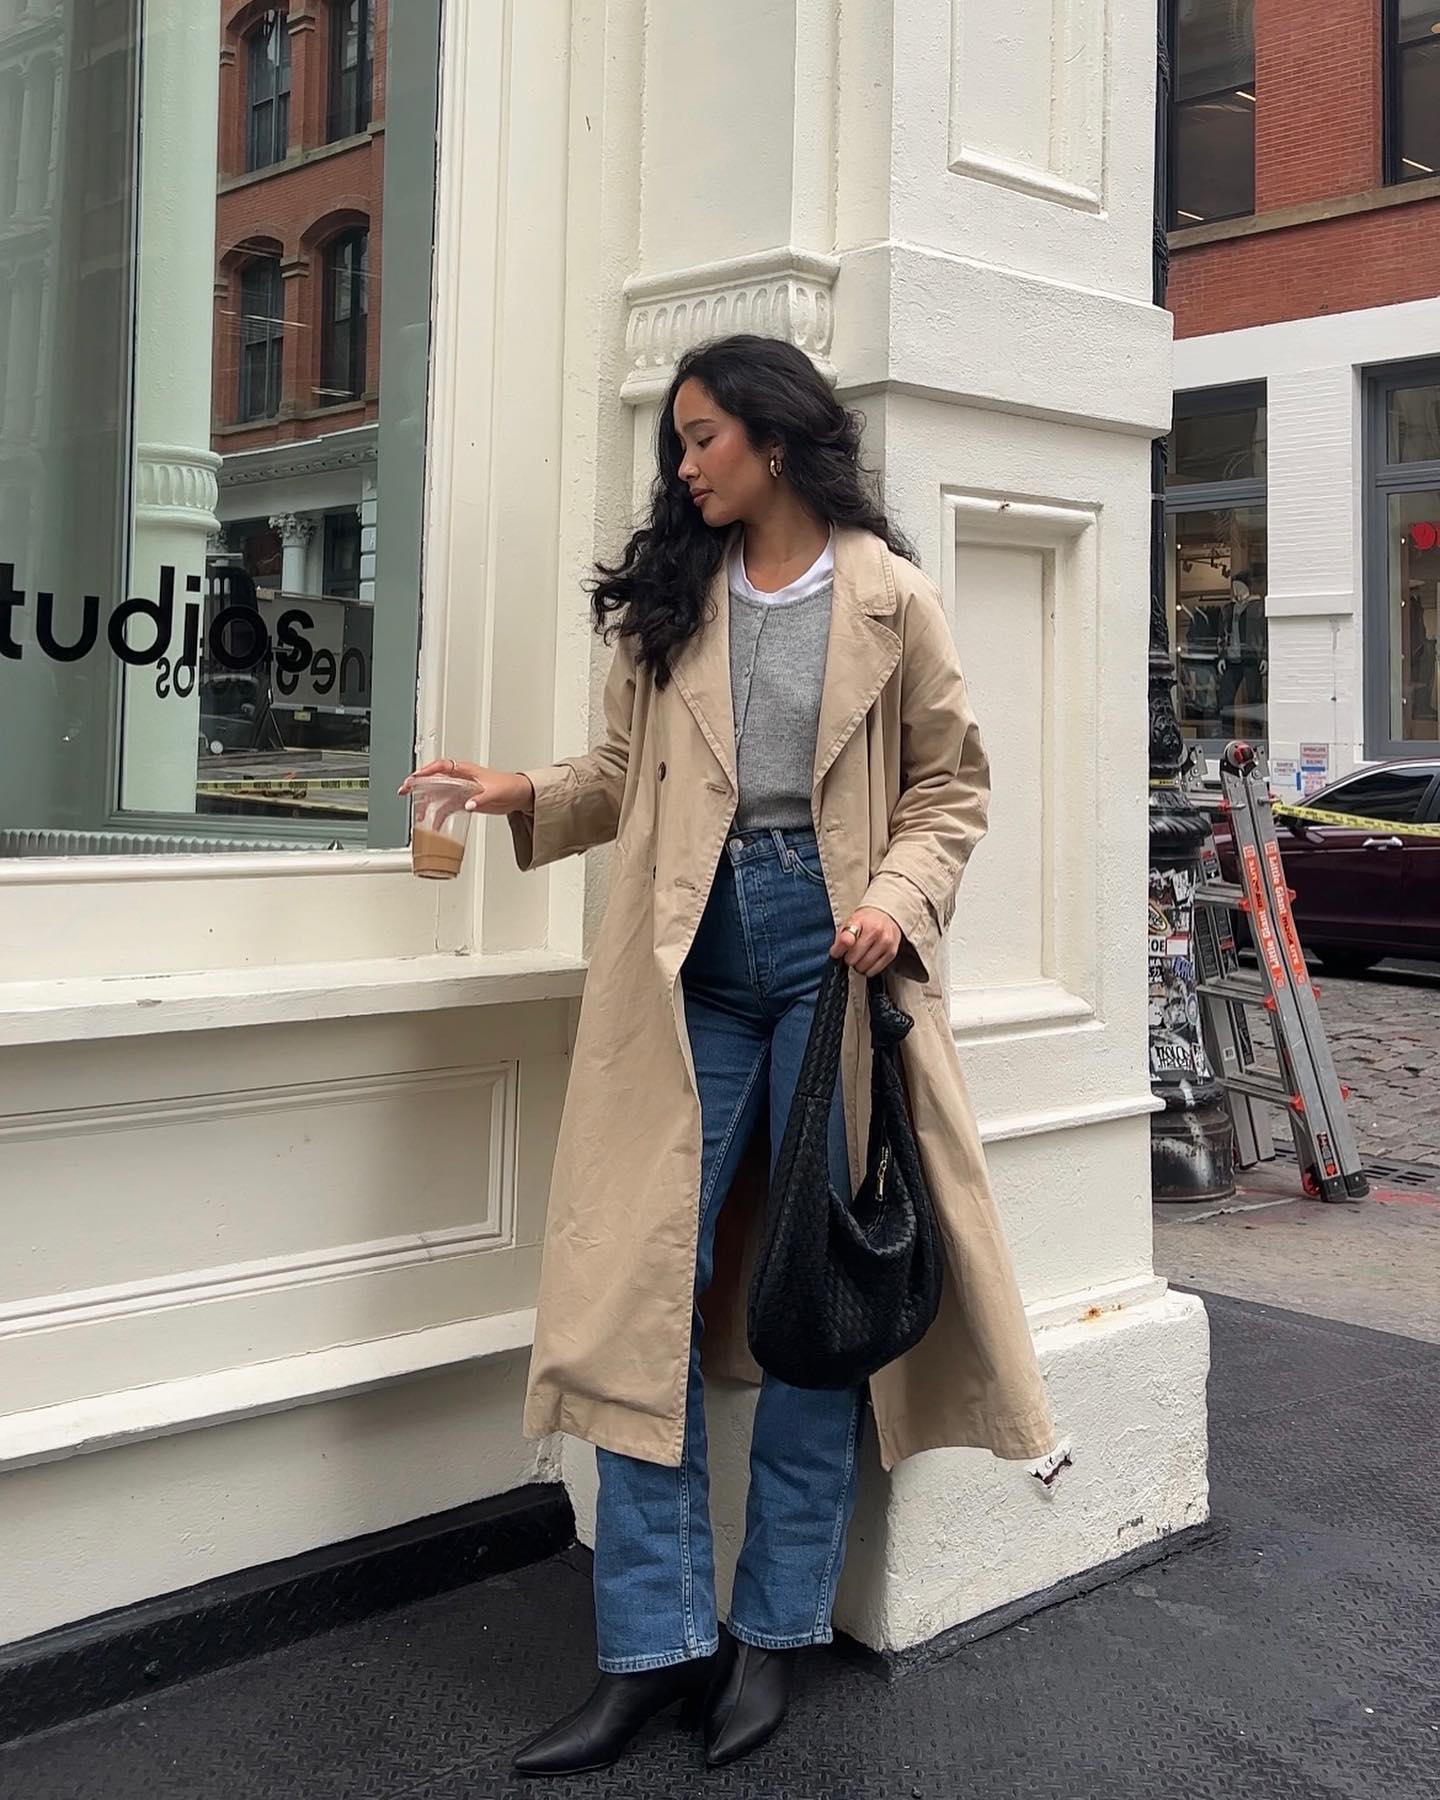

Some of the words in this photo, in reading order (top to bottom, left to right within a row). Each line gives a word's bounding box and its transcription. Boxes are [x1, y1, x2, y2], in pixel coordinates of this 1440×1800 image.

[1269, 855, 1281, 885] Little
[1275, 886, 1287, 914] Giant
[1259, 910, 1271, 938] Giant
[1267, 940, 1280, 969] Little
